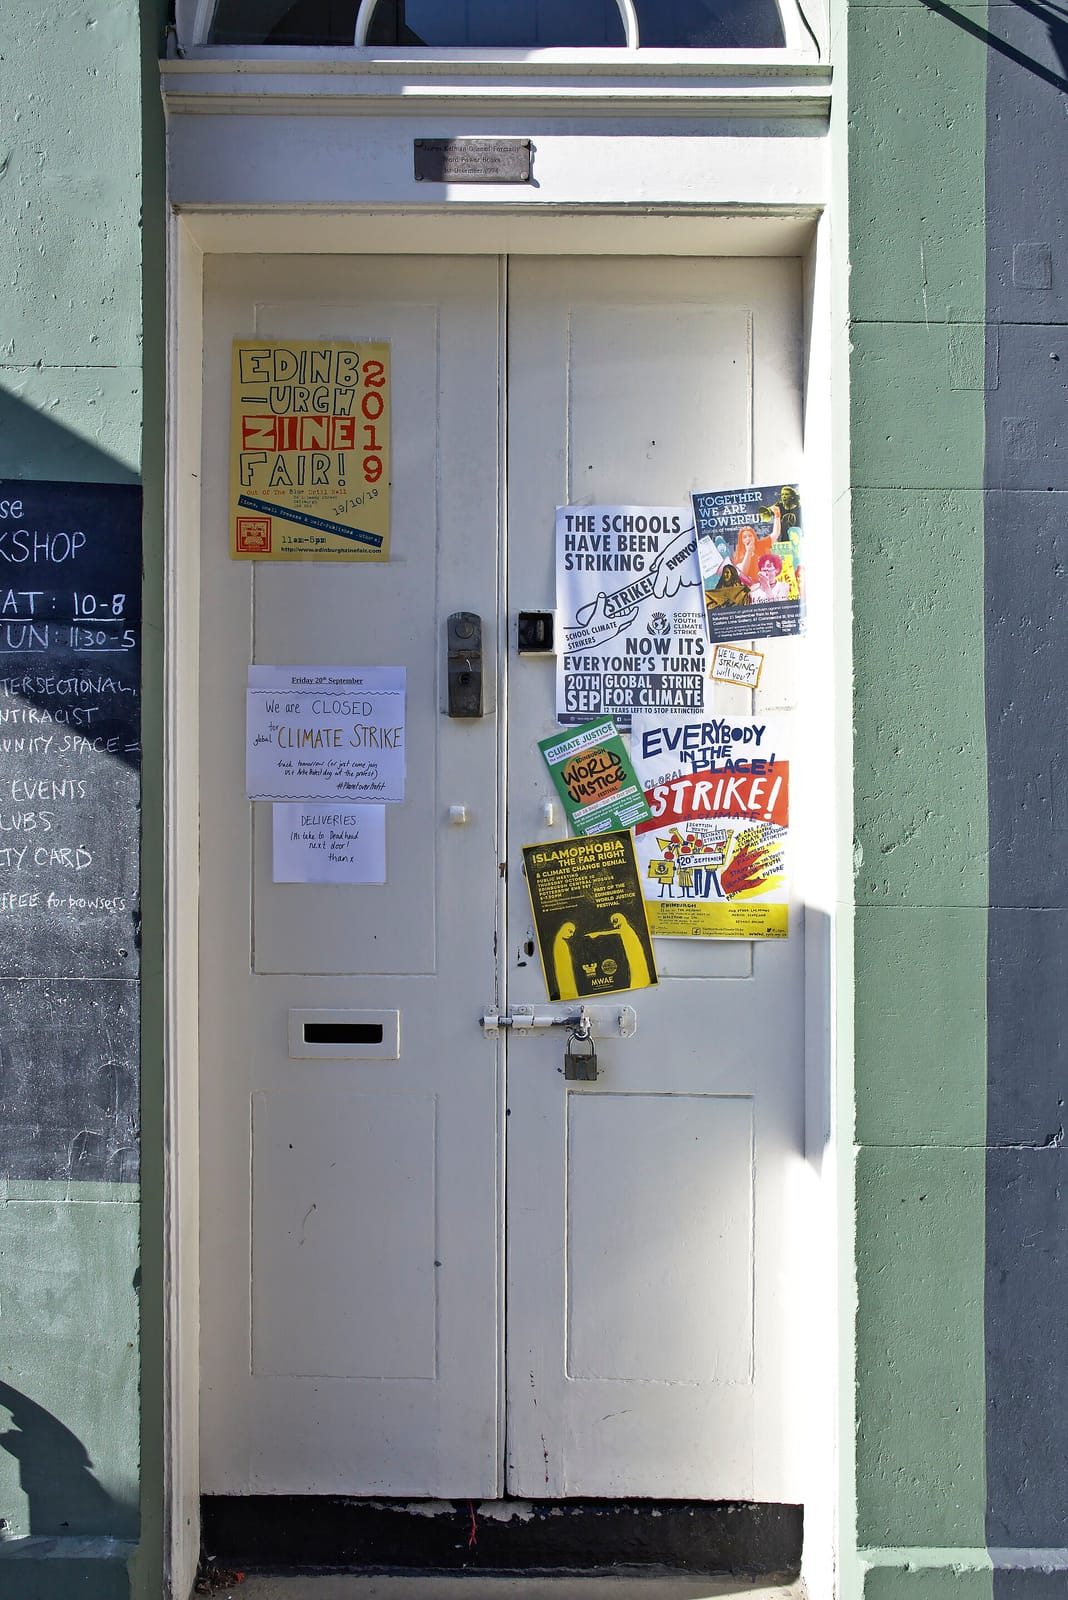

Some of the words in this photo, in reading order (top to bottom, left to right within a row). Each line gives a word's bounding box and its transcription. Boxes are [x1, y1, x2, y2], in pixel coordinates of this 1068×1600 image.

[239, 349, 359, 387] EDINB
[242, 415, 355, 452] ZINE
[239, 452, 346, 487] FAIR!
[333, 488, 379, 516] 19/10/19
[697, 492, 762, 507] TOGETHER
[699, 507, 719, 518] WE
[723, 504, 747, 516] ARE
[565, 515, 595, 533] THE
[601, 515, 681, 534] SCHOOLS
[281, 536, 327, 546] 11am-5pm
[565, 535, 611, 552] HAVE
[617, 535, 659, 552] BEEN
[565, 553, 645, 572] STRIKING
[565, 629, 590, 642] SCHOOL
[591, 621, 618, 634] CLIMATE
[567, 637, 596, 650] STRIKERS
[626, 637, 671, 655] NOW
[678, 638, 705, 656] ITS
[564, 656, 656, 672] EVERYONE'S
[662, 657, 706, 673] TURN!
[291, 677, 314, 685] Friday
[328, 677, 364, 685] September
[567, 675, 600, 690] 20TH
[605, 675, 652, 688] GLOBAL
[661, 675, 701, 689] STRIKE
[265, 700, 280, 713] We
[285, 703, 300, 714] are
[312, 700, 373, 716] CLOSED
[567, 690, 600, 712] SEP
[605, 689, 634, 705] FOR
[639, 689, 702, 706] CLIMATE
[0, 736, 53, 754] UNITY
[58, 736, 120, 755] SPACE
[277, 726, 344, 749] CLIMATE
[349, 723, 403, 749] STRIKE
[548, 739, 580, 758] CLIMATE
[582, 724, 613, 743] JUSTICE
[642, 718, 766, 759] EVERYBODY
[680, 750, 694, 763] IN
[697, 745, 733, 759] THE
[692, 752, 776, 775] PLACE!
[561, 751, 622, 785] WORLD
[568, 766, 627, 803] JUSTICE
[644, 769, 685, 789] GLOBAL
[12, 779, 87, 801] EVENTS
[597, 786, 618, 798] FESTIVAL
[651, 776, 783, 819] STRIKE!
[301, 815, 357, 826] DELIVERIES
[697, 812, 761, 823] CLIMATE
[309, 841, 326, 850] next
[318, 832, 325, 840] to
[34, 848, 92, 871] CARD
[532, 840, 624, 864] ISLAMOPHOBIA
[558, 858, 576, 868] THE
[578, 855, 596, 864] FAR
[598, 849, 625, 861] RIGHT
[694, 856, 722, 864] SEPTEMBER
[542, 867, 571, 878] CLIMATE
[572, 862, 601, 873] CHANGE
[602, 858, 627, 868] DENIAL
[565, 875, 588, 883] OCTOBER
[47, 892, 67, 909] for
[69, 894, 126, 911] browsers
[615, 892, 636, 900] JUSTICE
[592, 976, 614, 986] MWAE
